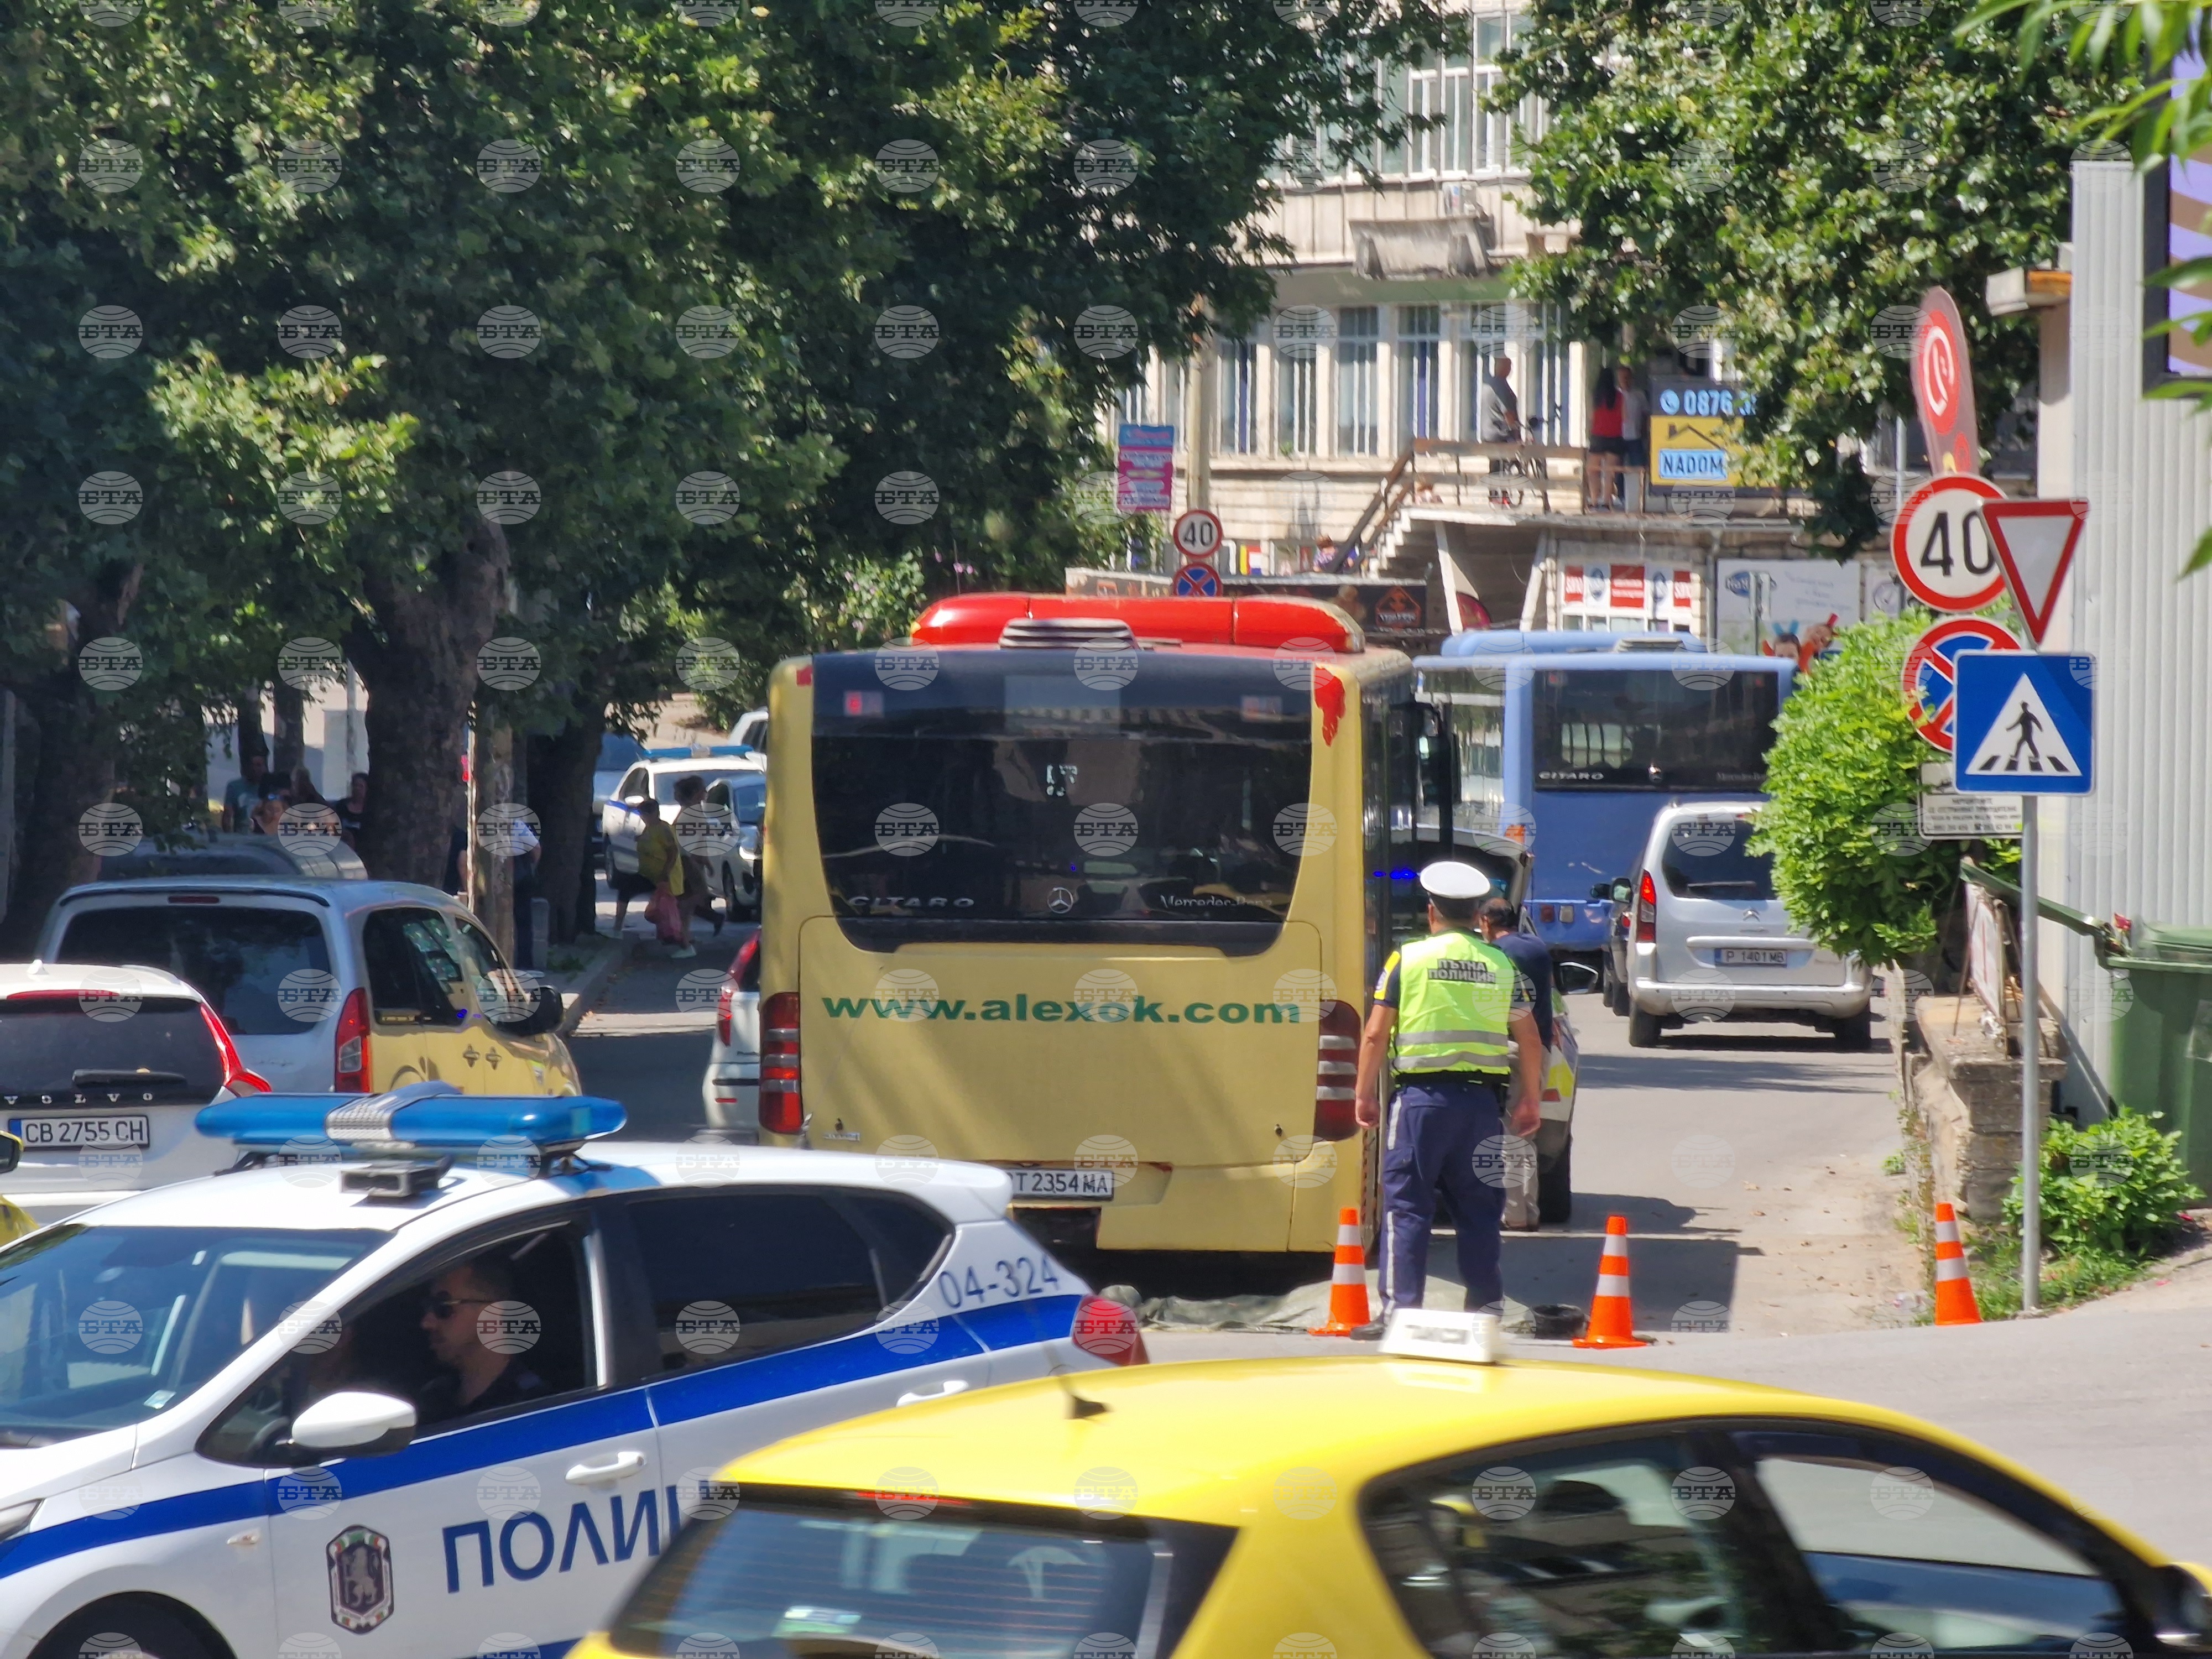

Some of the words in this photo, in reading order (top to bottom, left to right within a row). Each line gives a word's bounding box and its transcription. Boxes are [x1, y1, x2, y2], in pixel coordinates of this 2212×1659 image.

[1683, 389, 1733, 416] 0876
[1183, 521, 1213, 547] 40
[1920, 511, 1995, 576] 40
[1538, 771, 1604, 780] CITARO
[847, 895, 974, 908] CITARO
[1438, 959, 1486, 972] ПЪТНА
[1741, 951, 1767, 962] 1401
[1428, 969, 1496, 983] ПОЛИЦИЯ
[822, 993, 1300, 1024] www.alexok.com
[4, 1093, 153, 1105] VOLVO
[26, 1122, 54, 1143] CB
[59, 1120, 110, 1142] 2755
[115, 1120, 144, 1141] CH
[1032, 1172, 1079, 1193] 2354
[1082, 1173, 1108, 1193] MA
[938, 1253, 1060, 1309] 04-324
